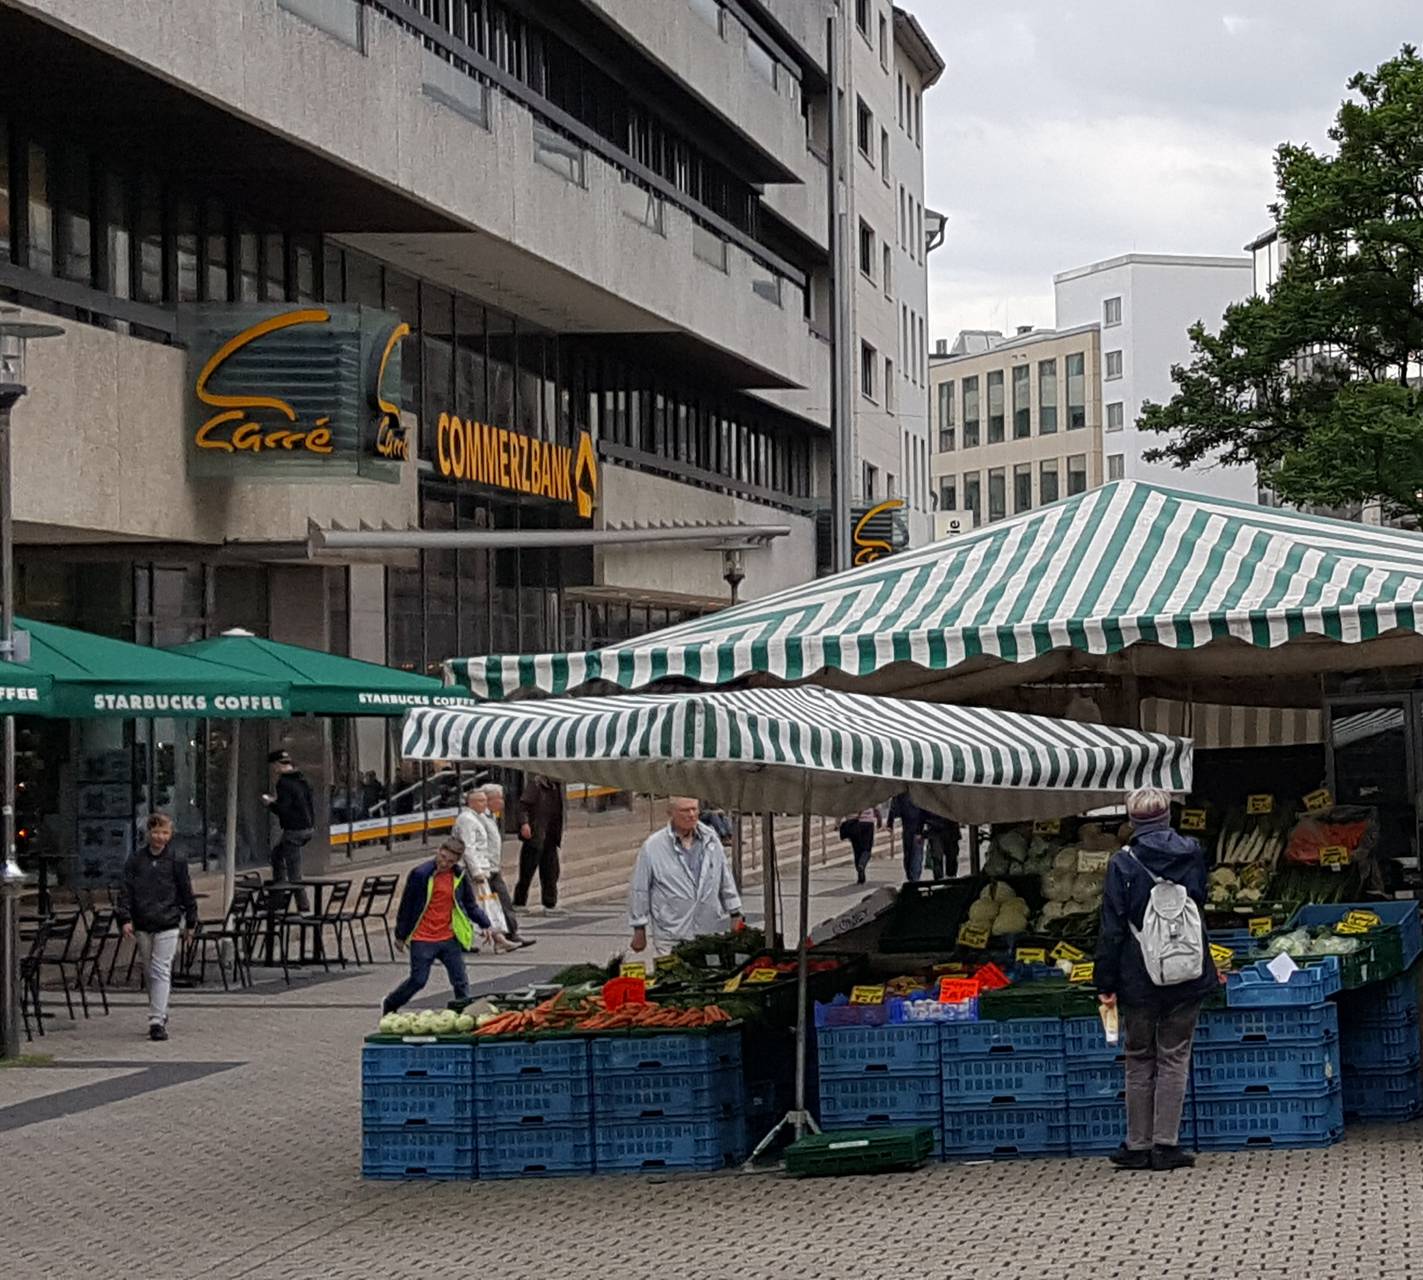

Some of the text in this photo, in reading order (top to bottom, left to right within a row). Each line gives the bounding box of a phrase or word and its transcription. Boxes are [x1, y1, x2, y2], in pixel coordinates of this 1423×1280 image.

[195, 409, 333, 454] Carré
[437, 411, 573, 502] COMMERZBANK
[94, 694, 284, 711] STARBUCKS COFFEE
[358, 692, 476, 707] STARBUCKS COFFEE
